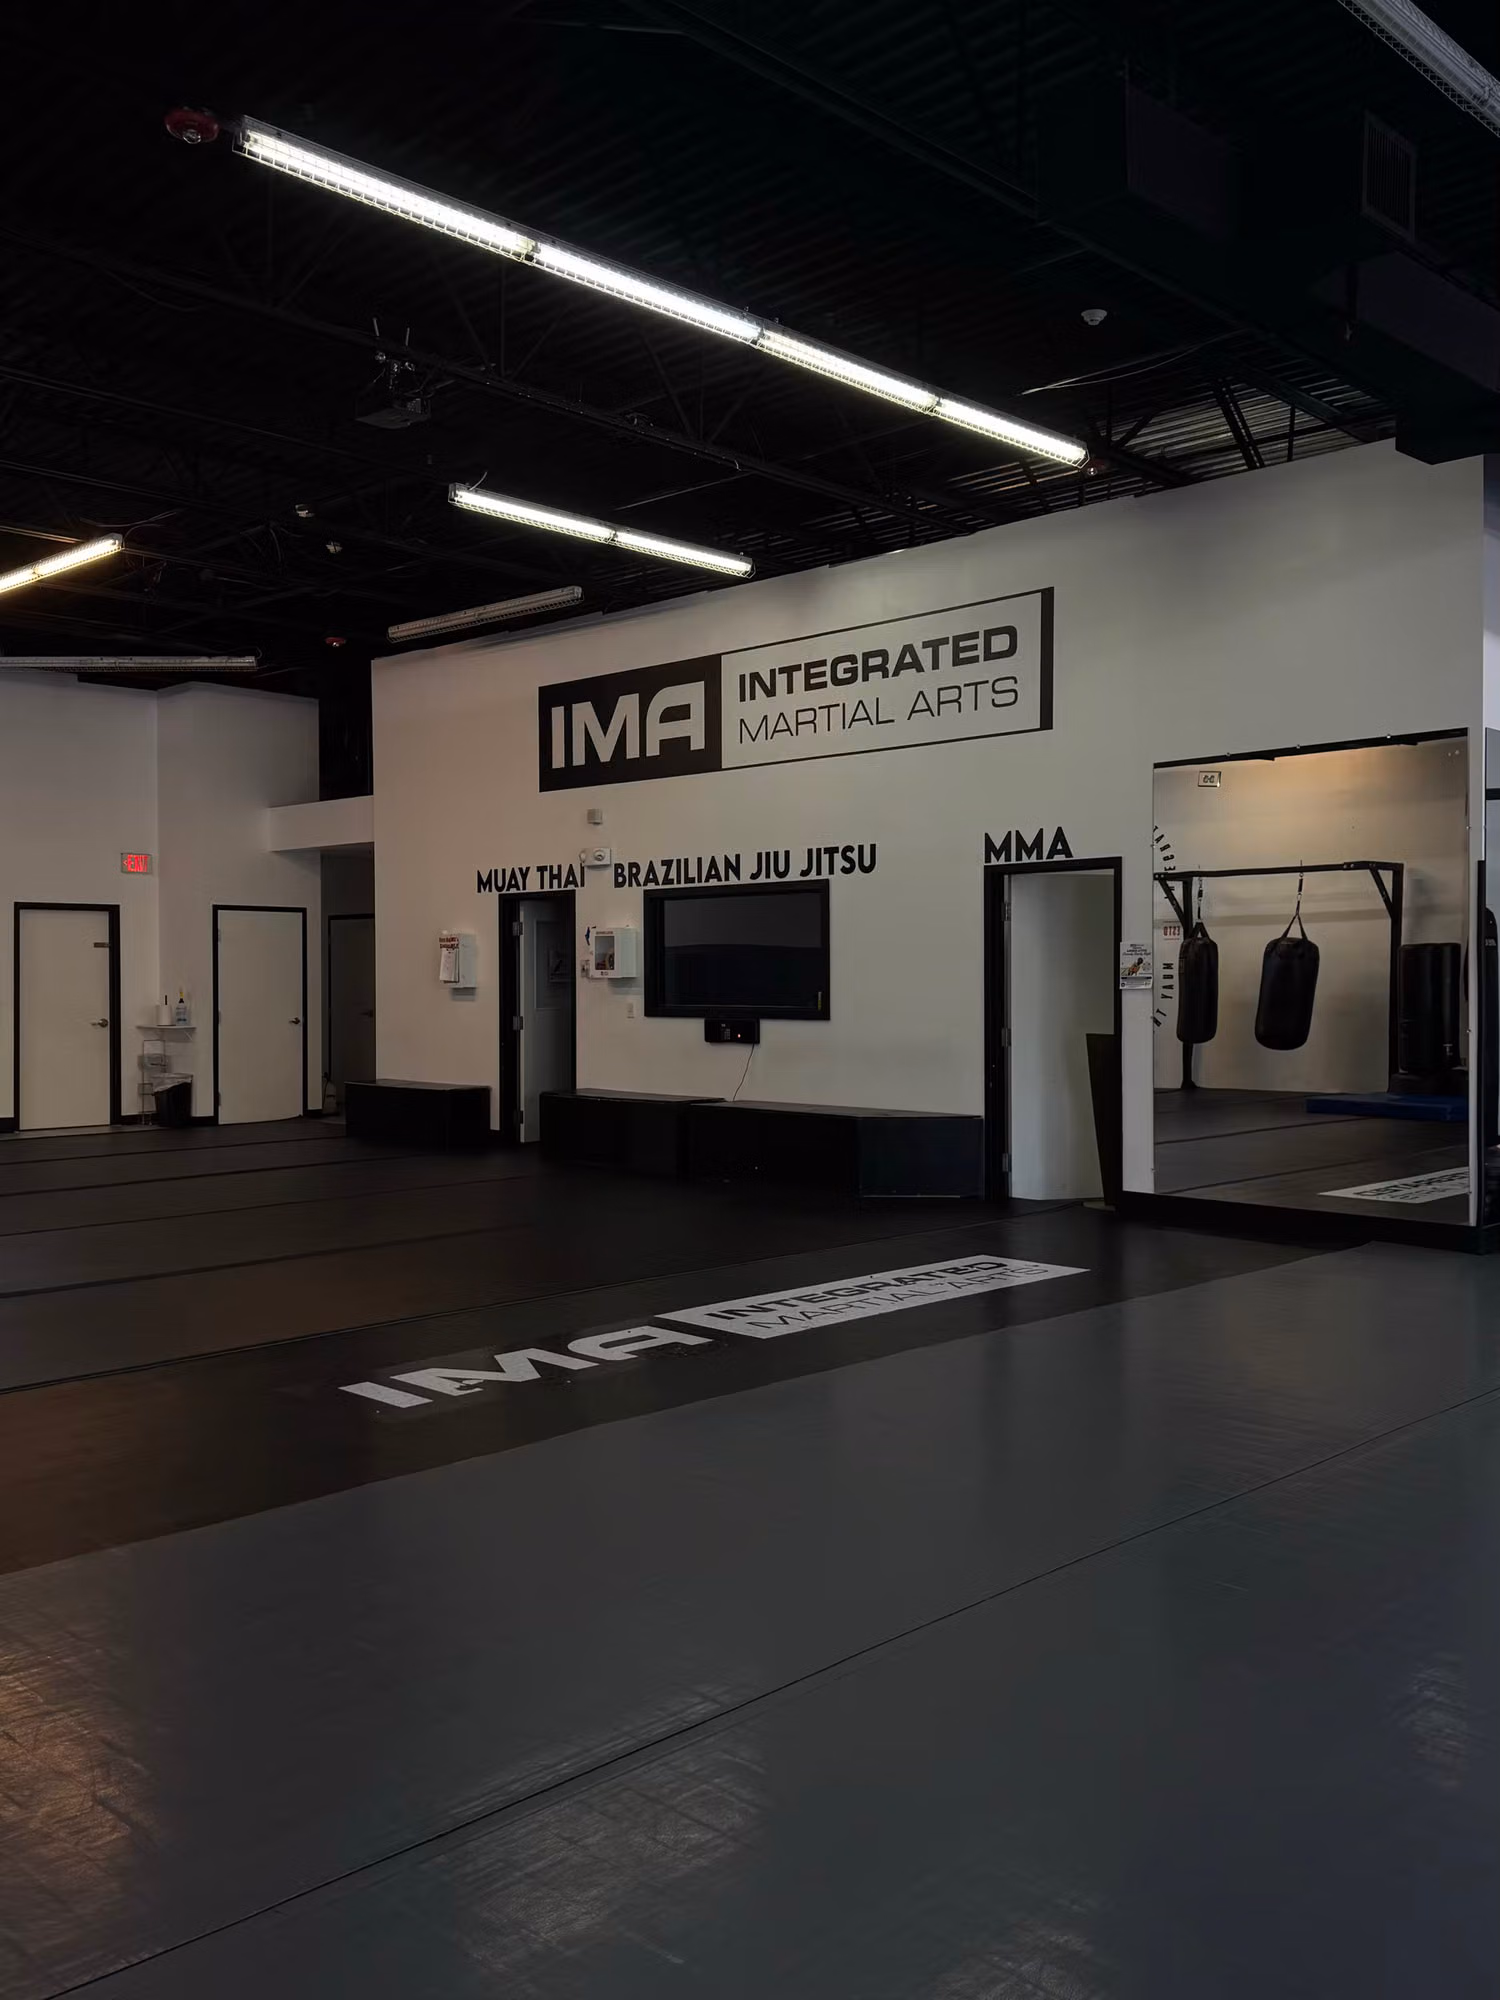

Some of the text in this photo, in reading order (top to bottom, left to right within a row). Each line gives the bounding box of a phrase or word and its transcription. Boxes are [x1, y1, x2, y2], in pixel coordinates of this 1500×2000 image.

[739, 625, 1018, 702] INTEGRATED
[551, 680, 705, 769] IMA
[739, 676, 1019, 743] MARTIAL ARTS
[614, 844, 877, 888] BRAZILIAN JIU JITSU
[984, 826, 1074, 864] MMA
[477, 863, 585, 893] MUAY THAI
[704, 1261, 1008, 1320] INTEGRATED
[746, 1265, 1049, 1329] MARTIAL ARTS
[337, 1325, 713, 1408] IMA
